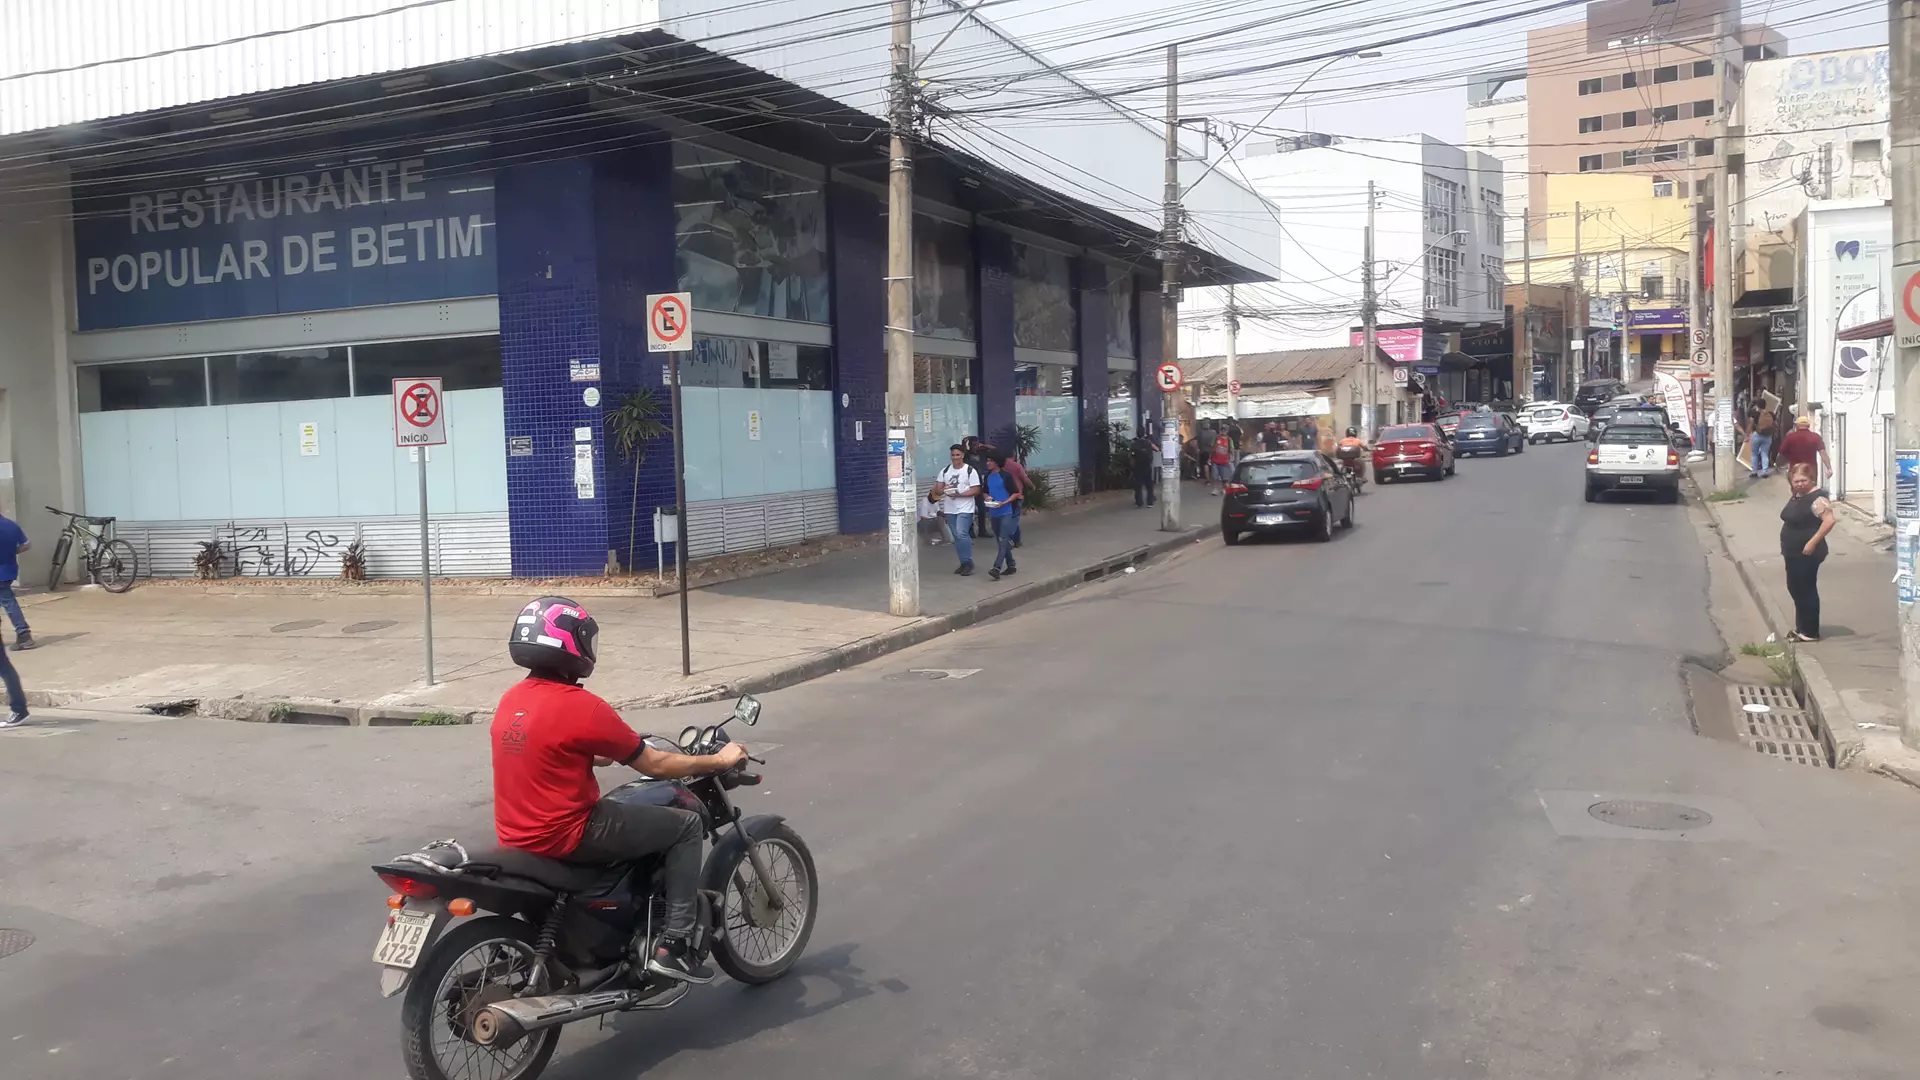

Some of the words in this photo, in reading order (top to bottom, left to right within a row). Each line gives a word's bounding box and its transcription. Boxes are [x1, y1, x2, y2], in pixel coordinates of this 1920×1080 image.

[129, 158, 427, 235] RESTAURANTE
[87, 240, 271, 295] POPULAR
[283, 231, 338, 276] DE
[350, 215, 484, 268] BETIM
[664, 307, 674, 330] E
[1697, 354, 1703, 362] E
[1164, 369, 1174, 385] E
[400, 432, 429, 443] INÍCIO
[501, 731, 527, 743] ZAZA
[386, 923, 424, 945] NYB
[378, 942, 417, 965] 4722
